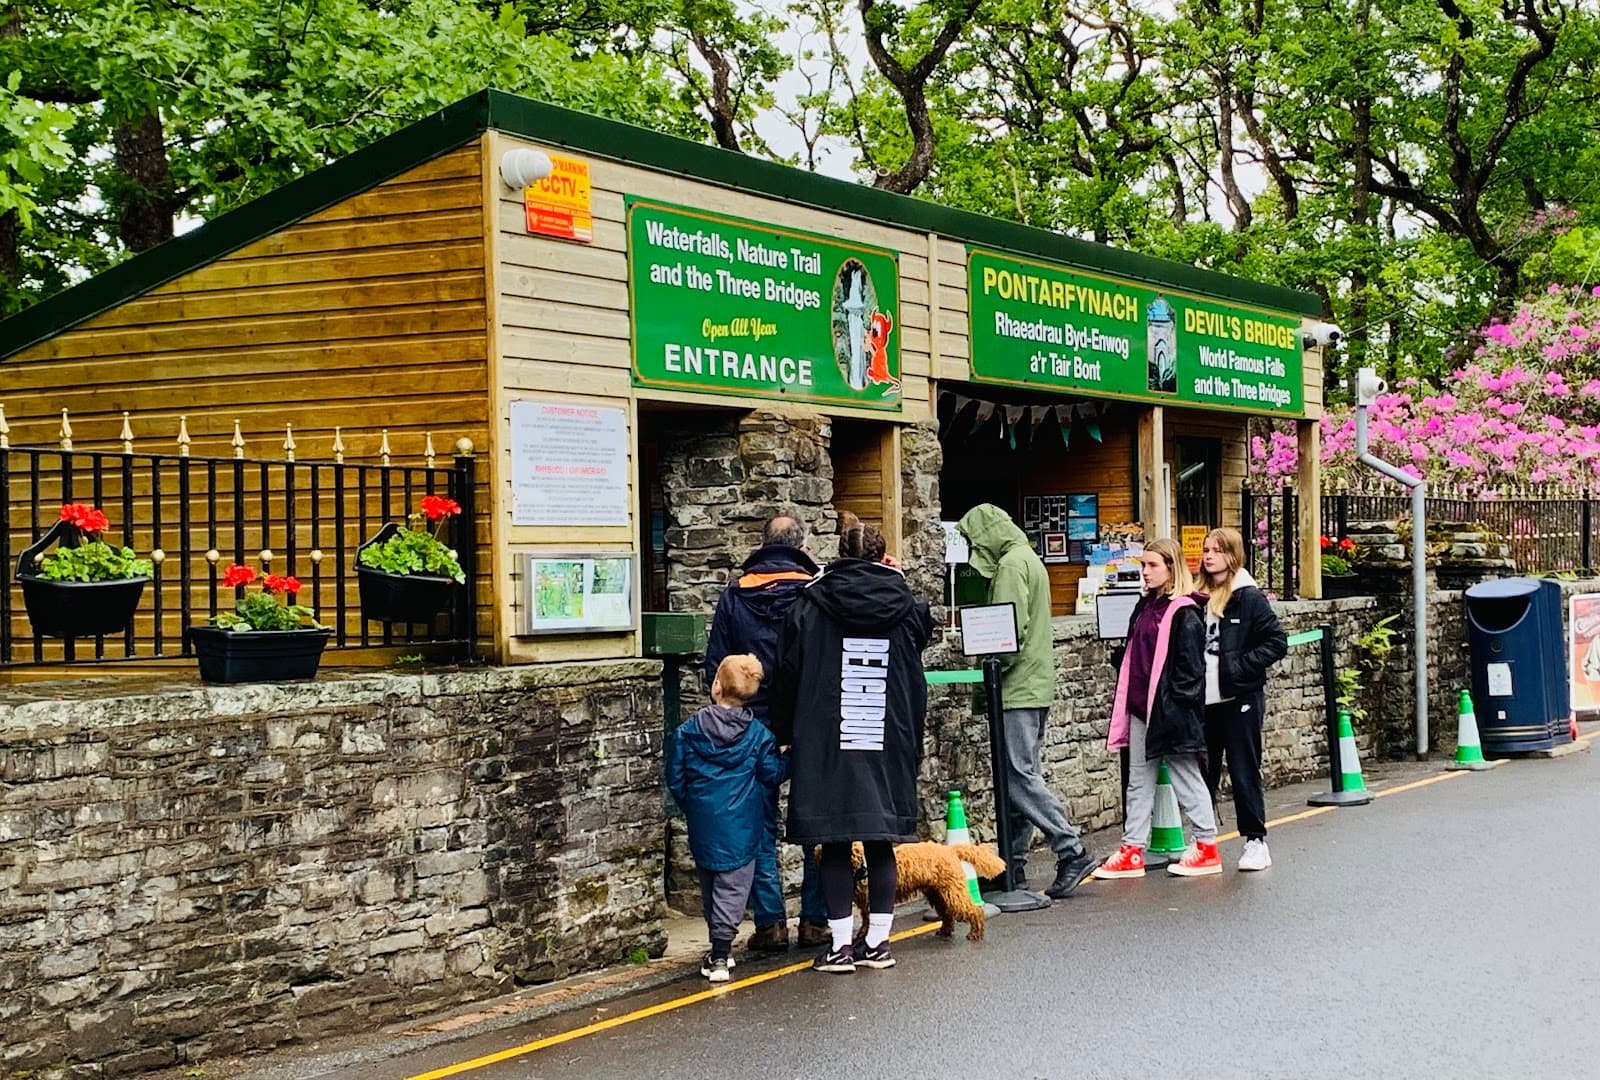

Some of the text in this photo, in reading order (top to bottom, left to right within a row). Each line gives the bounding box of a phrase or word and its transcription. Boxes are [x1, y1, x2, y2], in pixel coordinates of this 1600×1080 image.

[541, 174, 576, 198] CCTV
[645, 219, 822, 276] Waterfalls, Nature Trail
[650, 262, 821, 311] and the Three Bridges
[983, 267, 1138, 323] PONTARFYNACH
[702, 317, 778, 343] Open All Year
[995, 311, 1129, 360] Rhaeadrau Byd-Enwog
[1184, 307, 1296, 351] DEVIL'S BRIDGE
[664, 343, 813, 386] ENTRANCE
[1030, 350, 1101, 381] a'r Tair Bont
[1199, 345, 1286, 377] World Famous Falls
[1194, 375, 1291, 407] and the Three Bridges
[840, 638, 890, 751] BEACHBUM
